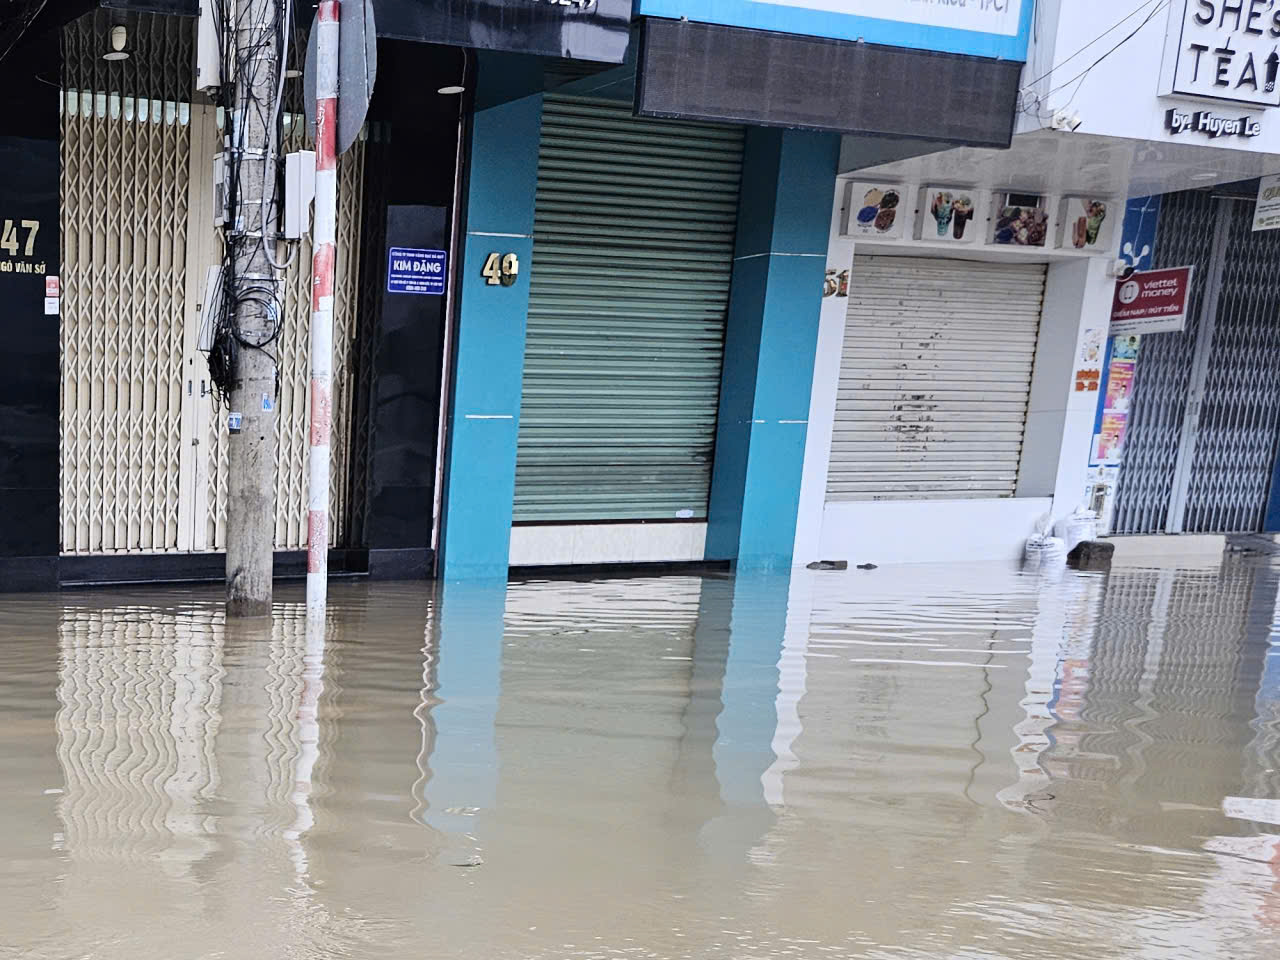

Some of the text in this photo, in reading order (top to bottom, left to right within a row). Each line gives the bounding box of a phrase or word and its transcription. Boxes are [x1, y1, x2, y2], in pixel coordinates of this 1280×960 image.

[1190, 37, 1258, 91] TEA
[1198, 111, 1240, 136] Huyen
[1244, 117, 1261, 135] Le
[0, 220, 40, 256] 47
[15, 261, 33, 273] VĂN
[34, 261, 46, 274] SỞ
[393, 260, 441, 275] KIM ĐẶNG
[483, 253, 518, 286] 49
[1141, 287, 1178, 298] money
[1144, 278, 1178, 288] viettel
